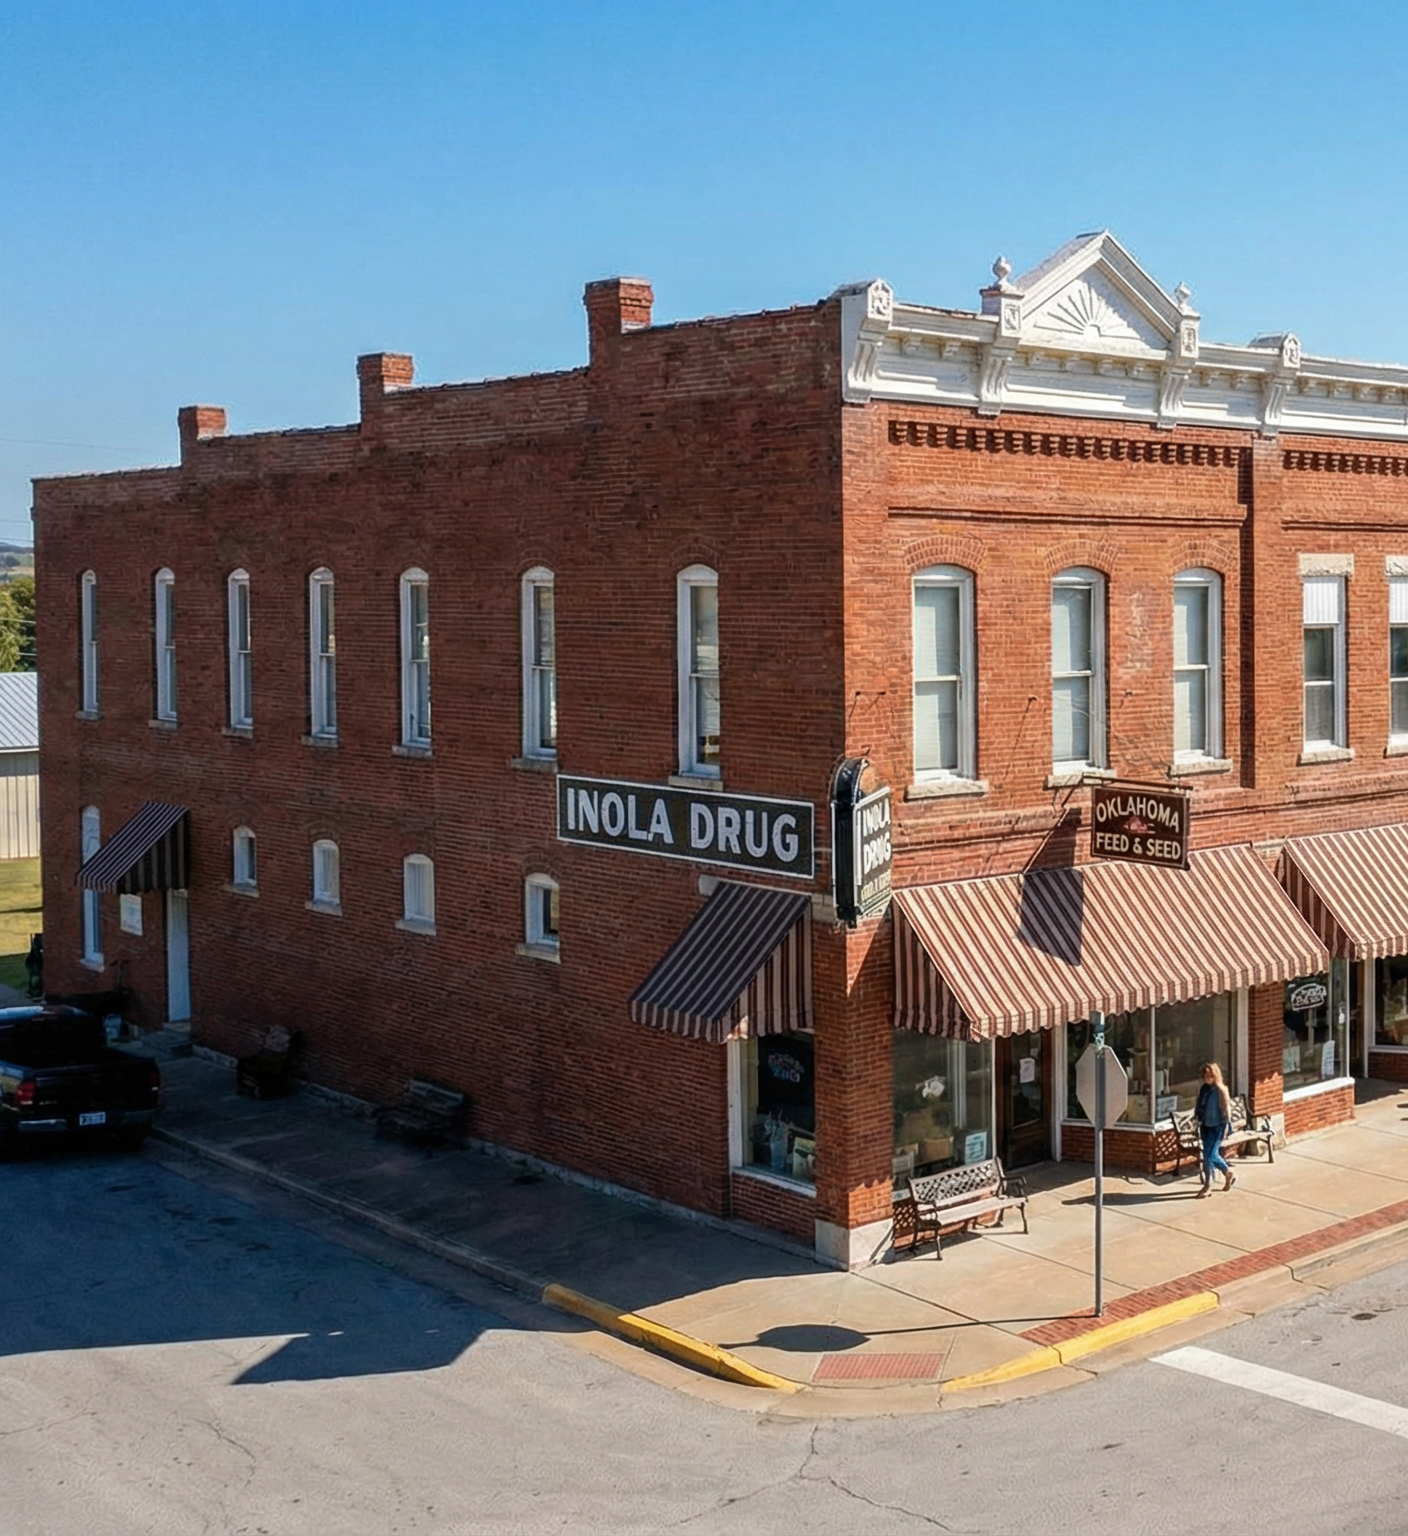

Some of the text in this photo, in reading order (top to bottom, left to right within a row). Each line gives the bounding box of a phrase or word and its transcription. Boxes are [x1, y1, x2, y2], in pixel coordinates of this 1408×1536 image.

[567, 787, 799, 863] INOLA DRUG
[862, 797, 891, 837] INOLA
[1096, 796, 1180, 833] OKLAHOMA
[863, 831, 891, 875] DRUG
[1096, 832, 1181, 860] FEED & SEED
